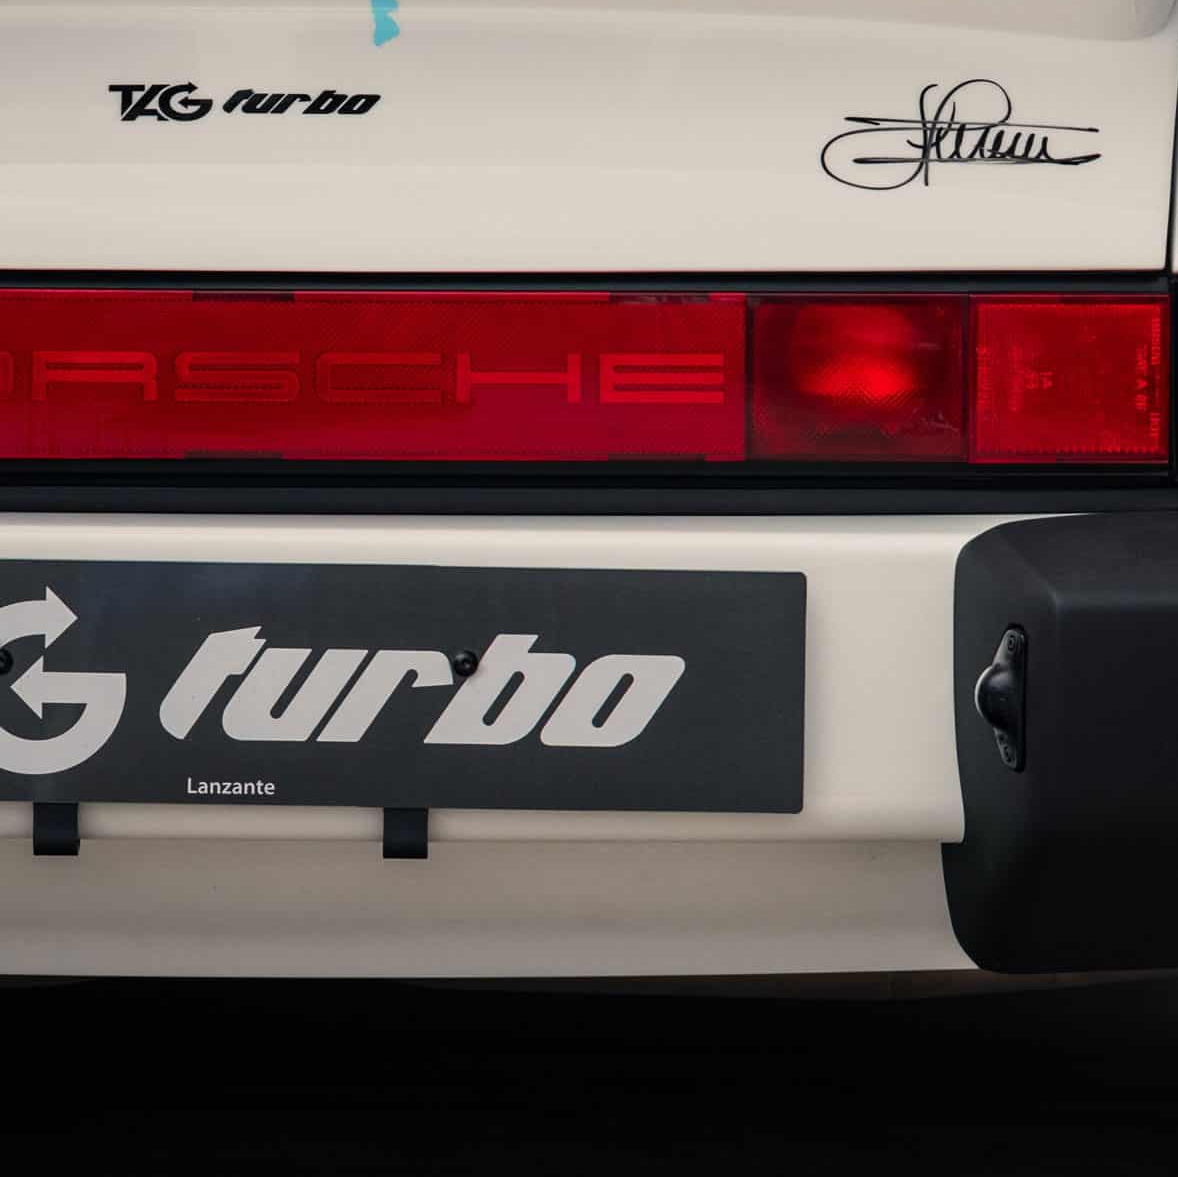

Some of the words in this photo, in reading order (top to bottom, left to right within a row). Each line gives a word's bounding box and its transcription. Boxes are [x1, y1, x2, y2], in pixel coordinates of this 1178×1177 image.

[108, 81, 214, 122] TAG
[222, 88, 381, 115] turbo
[0, 351, 725, 404] RSCHE
[159, 625, 686, 748] turbo
[187, 777, 276, 796] Lanzante
